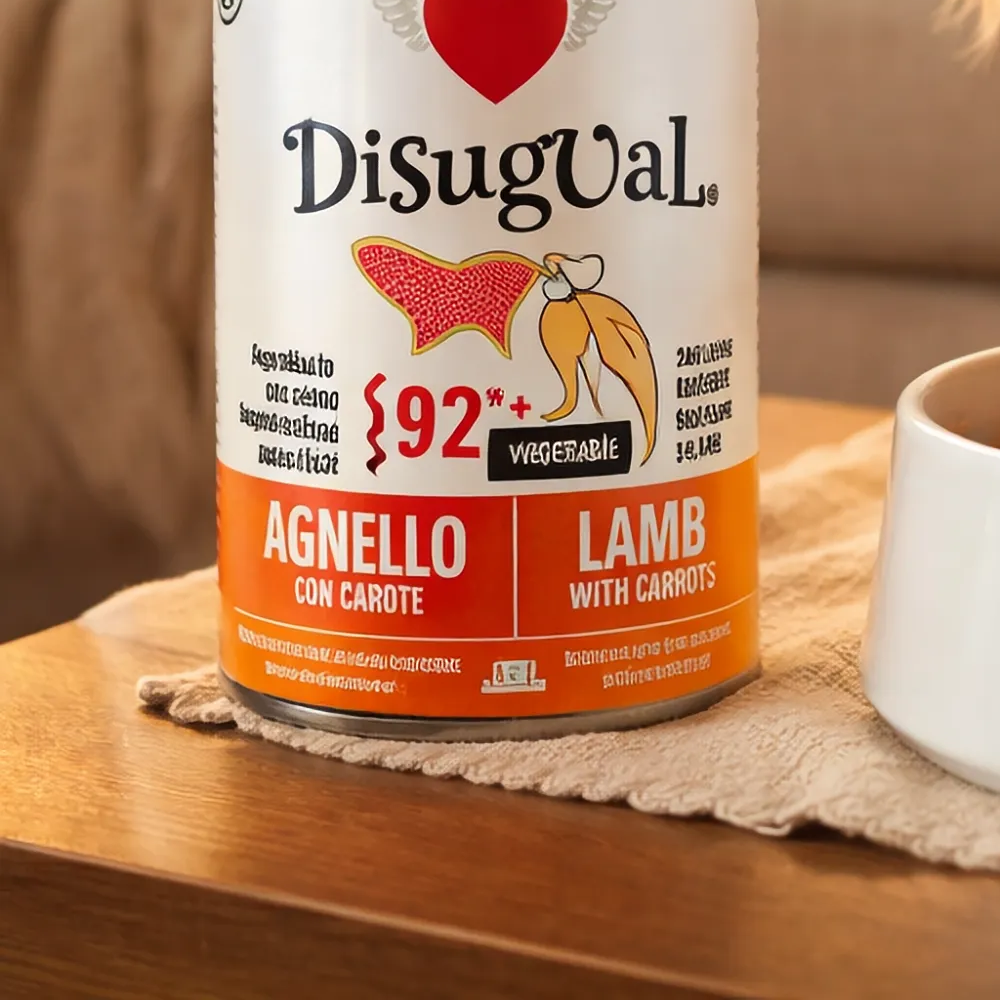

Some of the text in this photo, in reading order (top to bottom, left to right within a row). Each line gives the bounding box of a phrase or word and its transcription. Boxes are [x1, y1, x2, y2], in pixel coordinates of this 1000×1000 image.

[263, 500, 466, 578] AGNELLO
[579, 496, 706, 572] LAMB
[295, 576, 424, 615] CON CAROTE
[569, 560, 716, 609] WITH CARROTS
